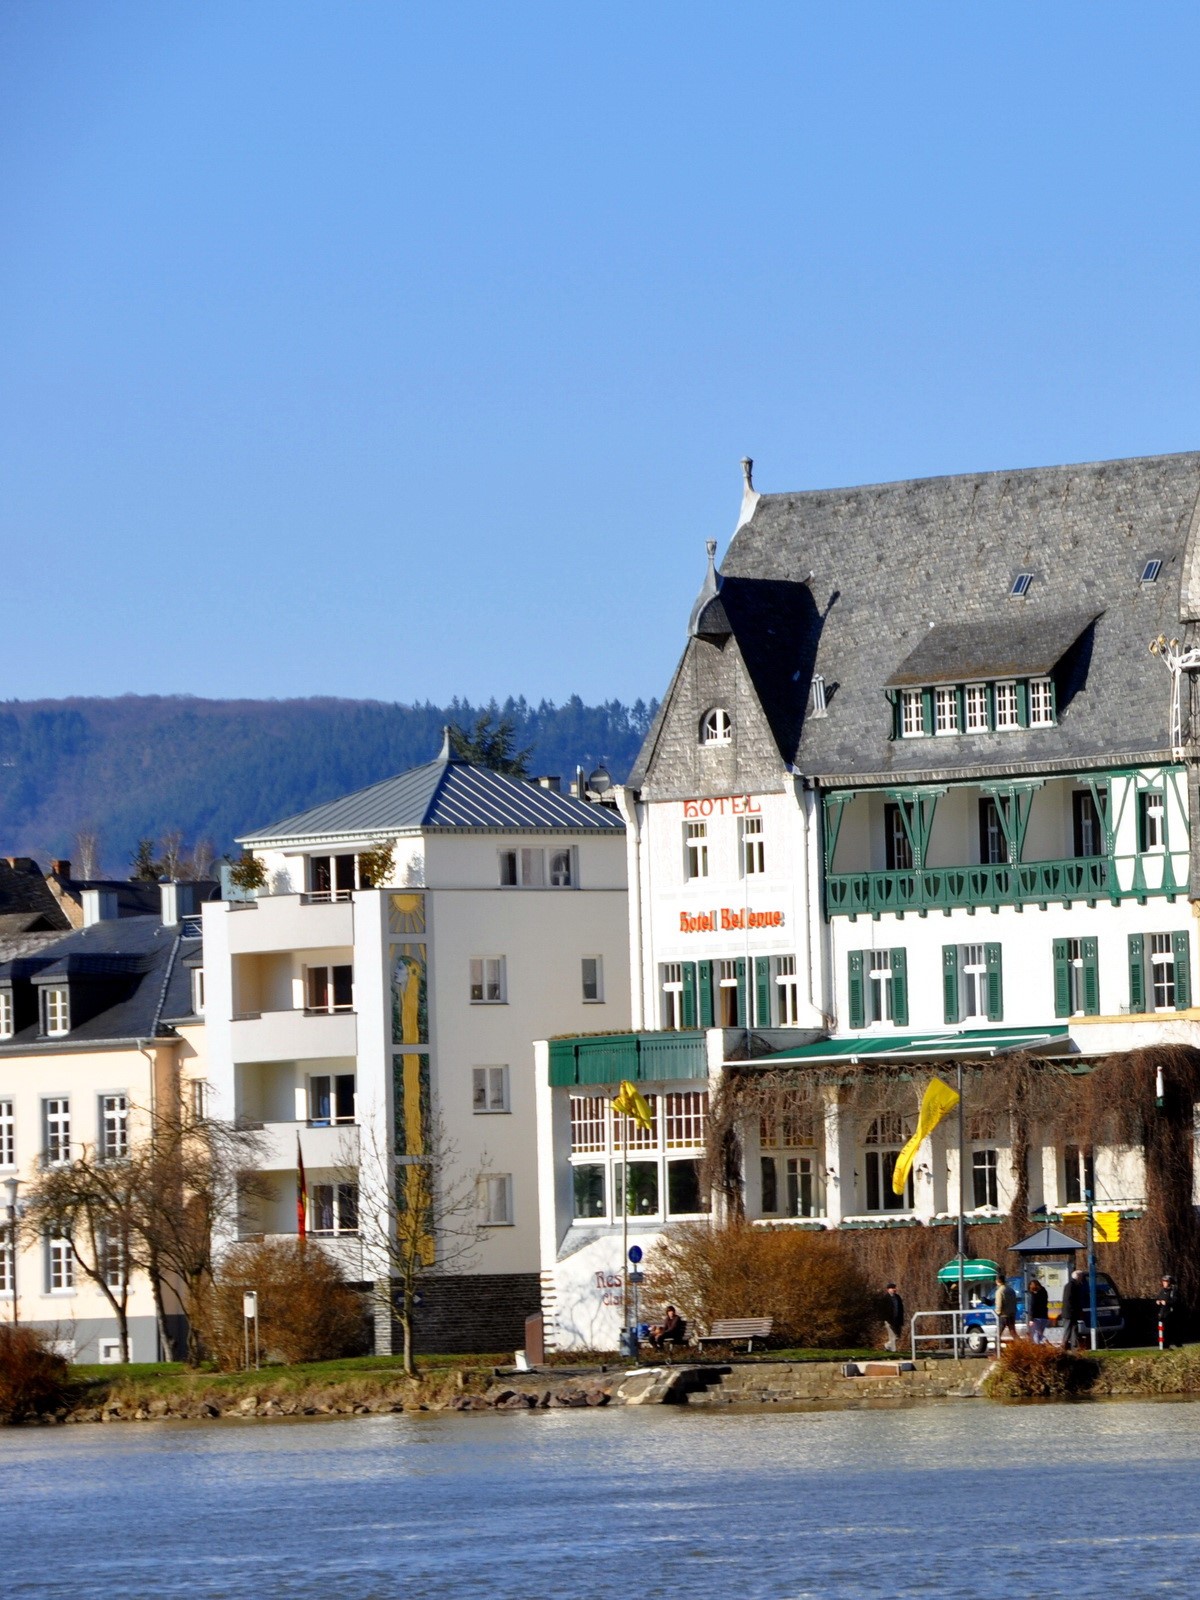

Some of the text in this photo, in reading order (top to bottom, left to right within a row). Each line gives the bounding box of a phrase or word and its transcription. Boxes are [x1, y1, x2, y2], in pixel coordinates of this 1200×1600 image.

[683, 794, 761, 818] HOTEL
[679, 907, 782, 932] Hotel Belevue
